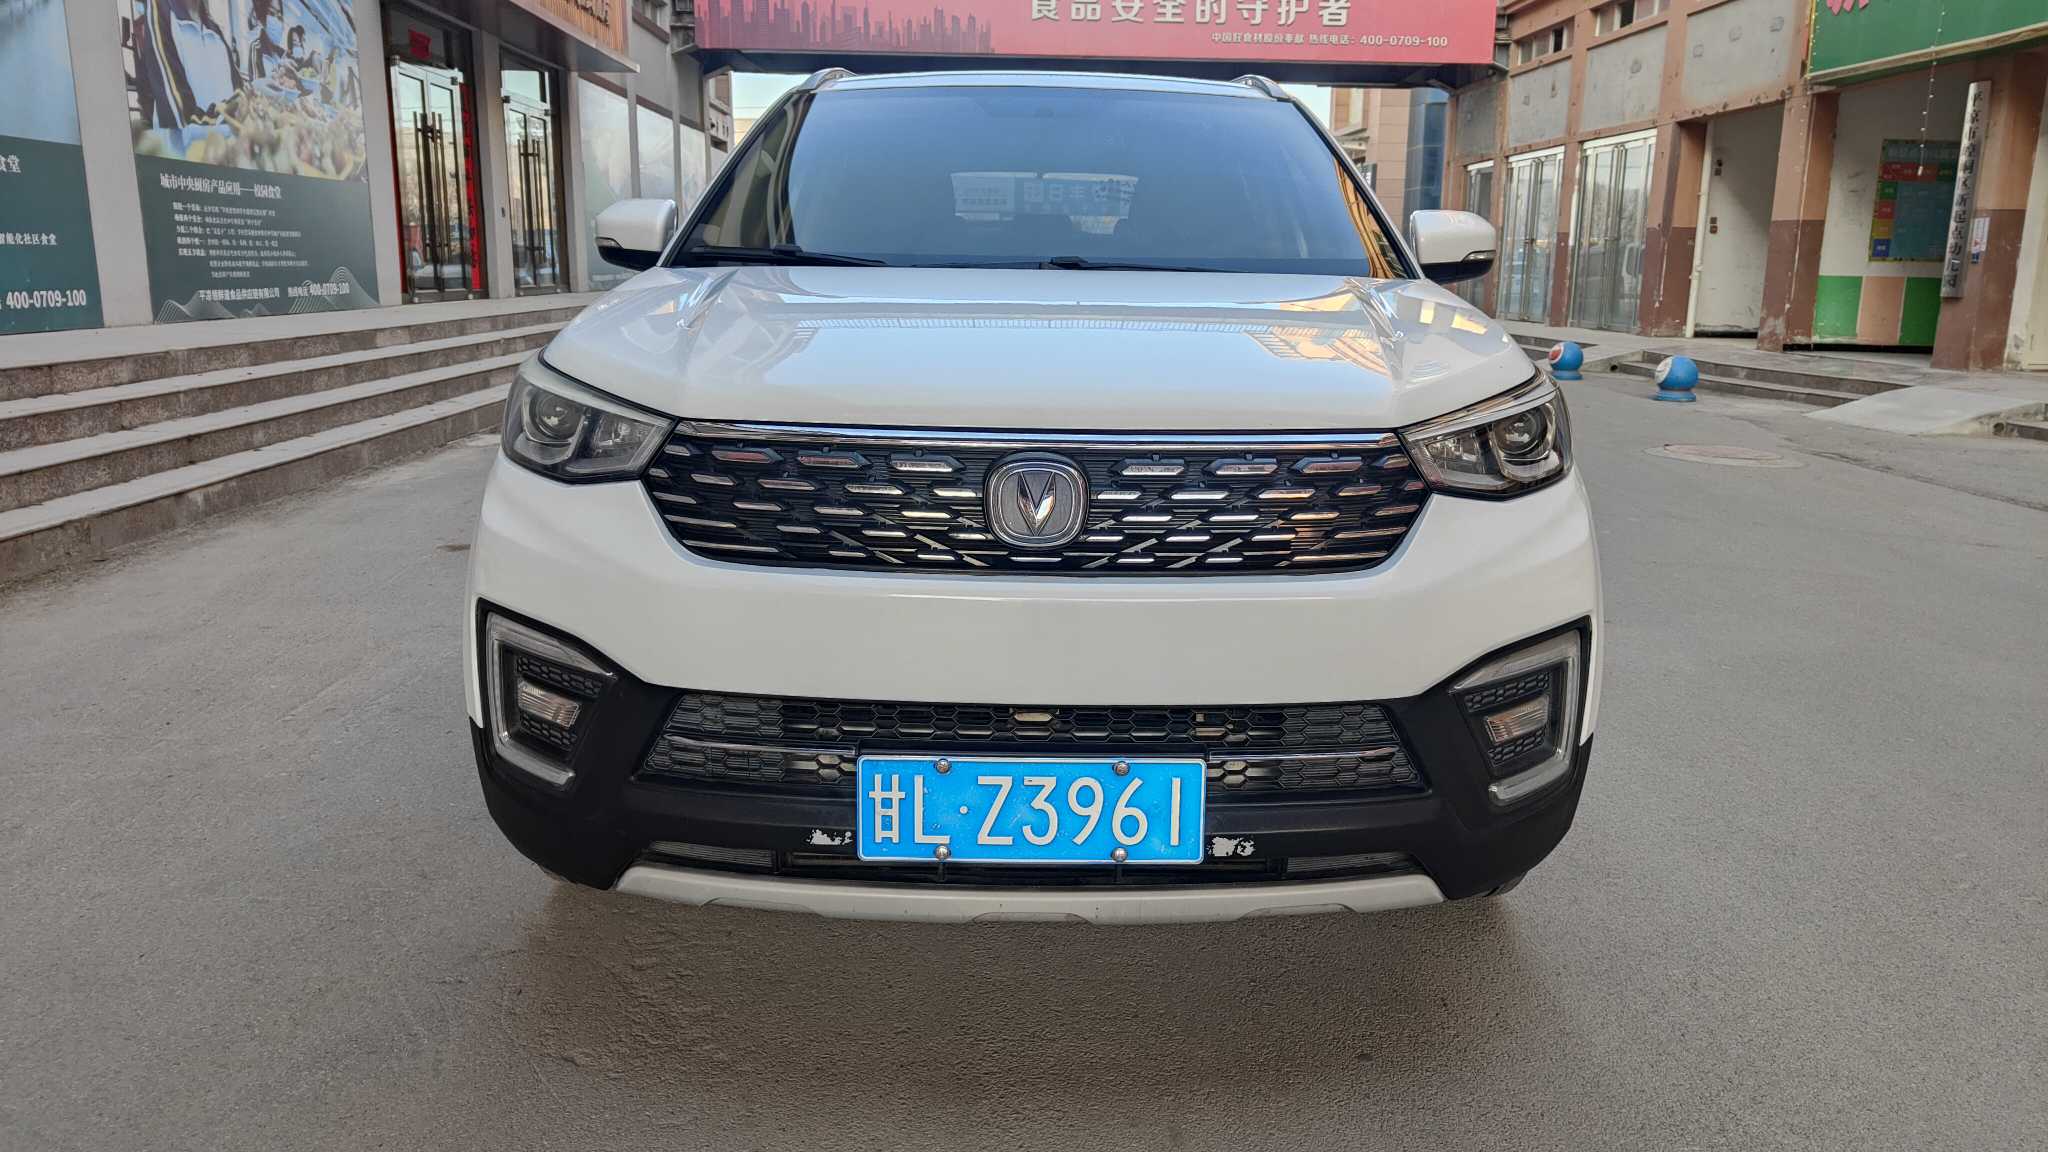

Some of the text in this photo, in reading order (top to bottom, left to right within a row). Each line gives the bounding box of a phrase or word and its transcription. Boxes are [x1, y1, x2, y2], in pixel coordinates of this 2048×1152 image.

[1360, 35, 1448, 47] 400-0709-100
[6, 289, 87, 309] 400-0709-100
[868, 773, 1182, 847] 甘L·Z3961
